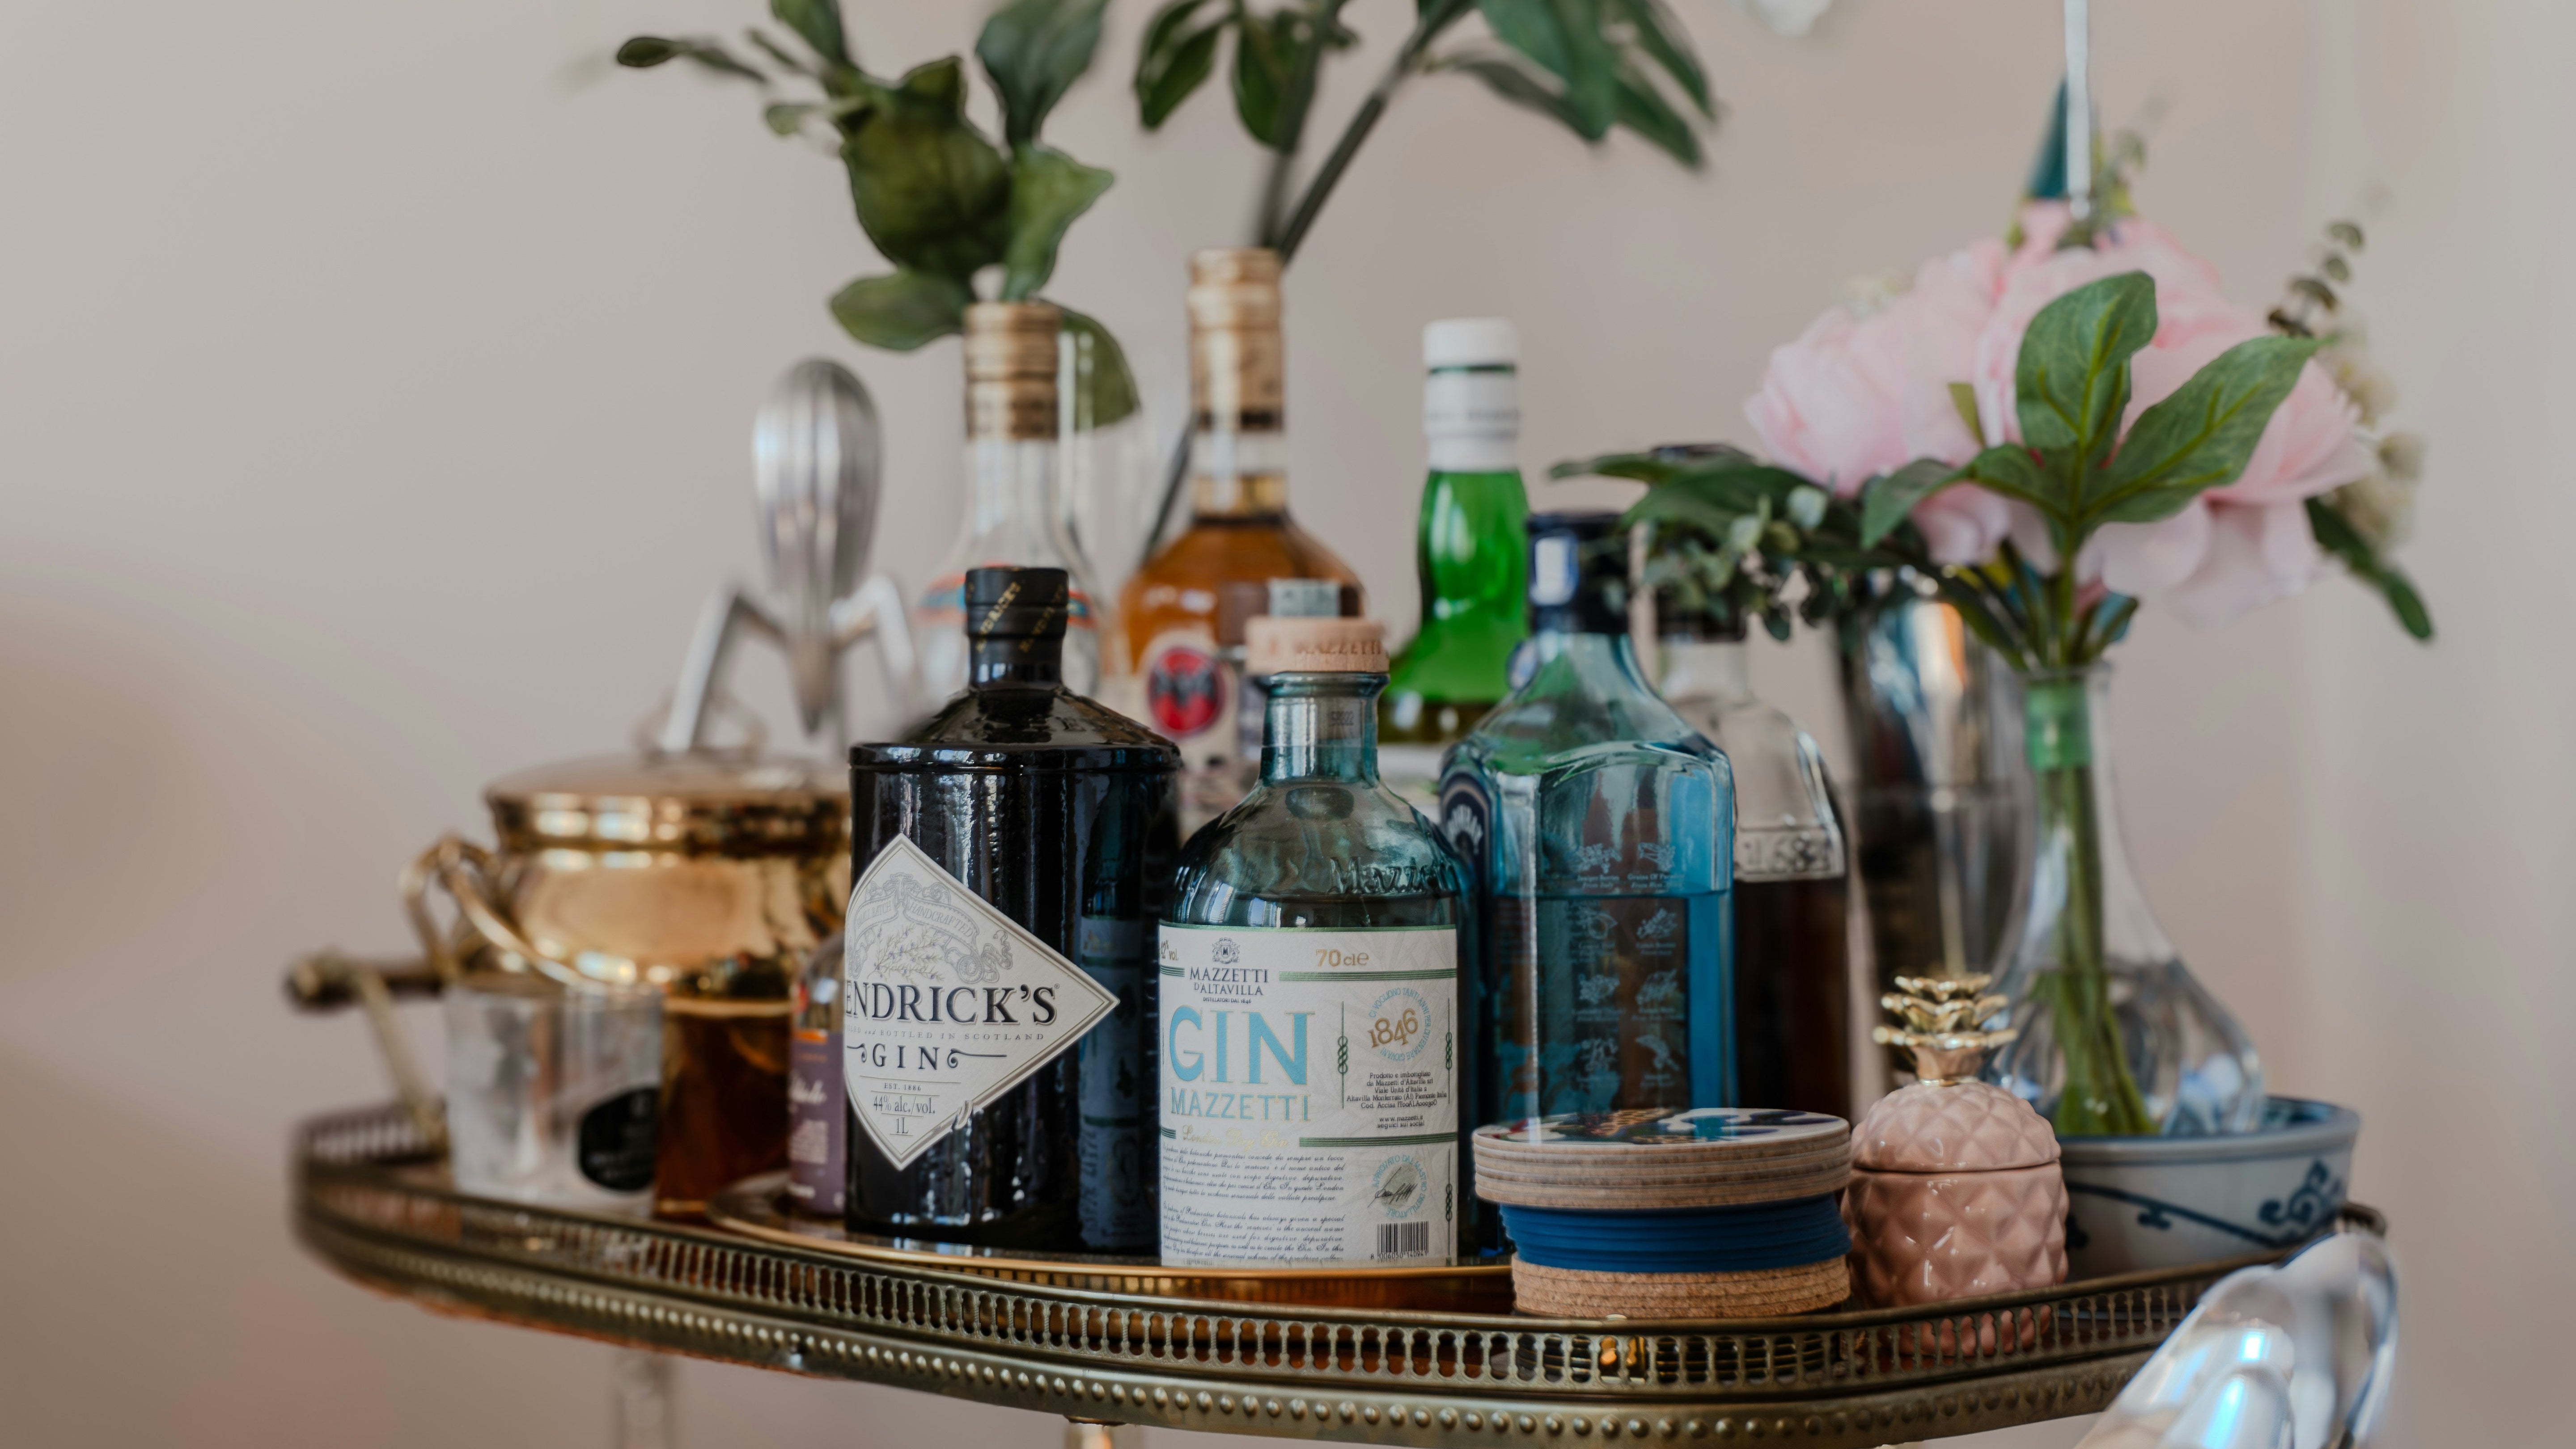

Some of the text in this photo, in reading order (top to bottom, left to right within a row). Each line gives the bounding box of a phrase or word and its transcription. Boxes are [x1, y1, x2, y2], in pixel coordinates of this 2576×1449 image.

[872, 901, 891, 917] BATCH
[908, 903, 974, 937] HANDCRAFTED
[1316, 948, 1341, 967] 70
[1190, 966, 1270, 983] MAZZETTI
[1194, 982, 1263, 995] D'ALTAVILLA
[847, 980, 1056, 1025] ENDRICK'S
[1402, 987, 1420, 1001] TANTI
[1418, 997, 1430, 1014] ANNI
[881, 1030, 933, 1039] BOTTLED
[1368, 1008, 1418, 1048] 1846
[1169, 1005, 1315, 1085] GIN
[872, 1043, 940, 1070] GIN
[873, 1095, 892, 1111] 44%
[1171, 1086, 1311, 1121] MAZZETTI
[896, 1117, 909, 1134] 1L
[1377, 1121, 1398, 1129] seguici
[1190, 1149, 1212, 1157] botaniche
[1287, 1154, 1311, 1163] sempre
[1221, 1158, 1233, 1168] Qui
[1372, 1155, 1400, 1187] APPROVATO
[1402, 1154, 1414, 1164] DAL
[1227, 1182, 1236, 1190] per
[1280, 1181, 1292, 1190] In
[1316, 1182, 1344, 1191] London
[1186, 1205, 1214, 1217] Piedmontese
[1217, 1211, 1246, 1220] botanicals
[1263, 1213, 1287, 1225] always
[1320, 1214, 1345, 1224] special
[1215, 1219, 1231, 1229] Here
[1238, 1241, 1250, 1249] well
[1316, 1242, 1330, 1251] In
[1249, 1232, 1260, 1243] for
